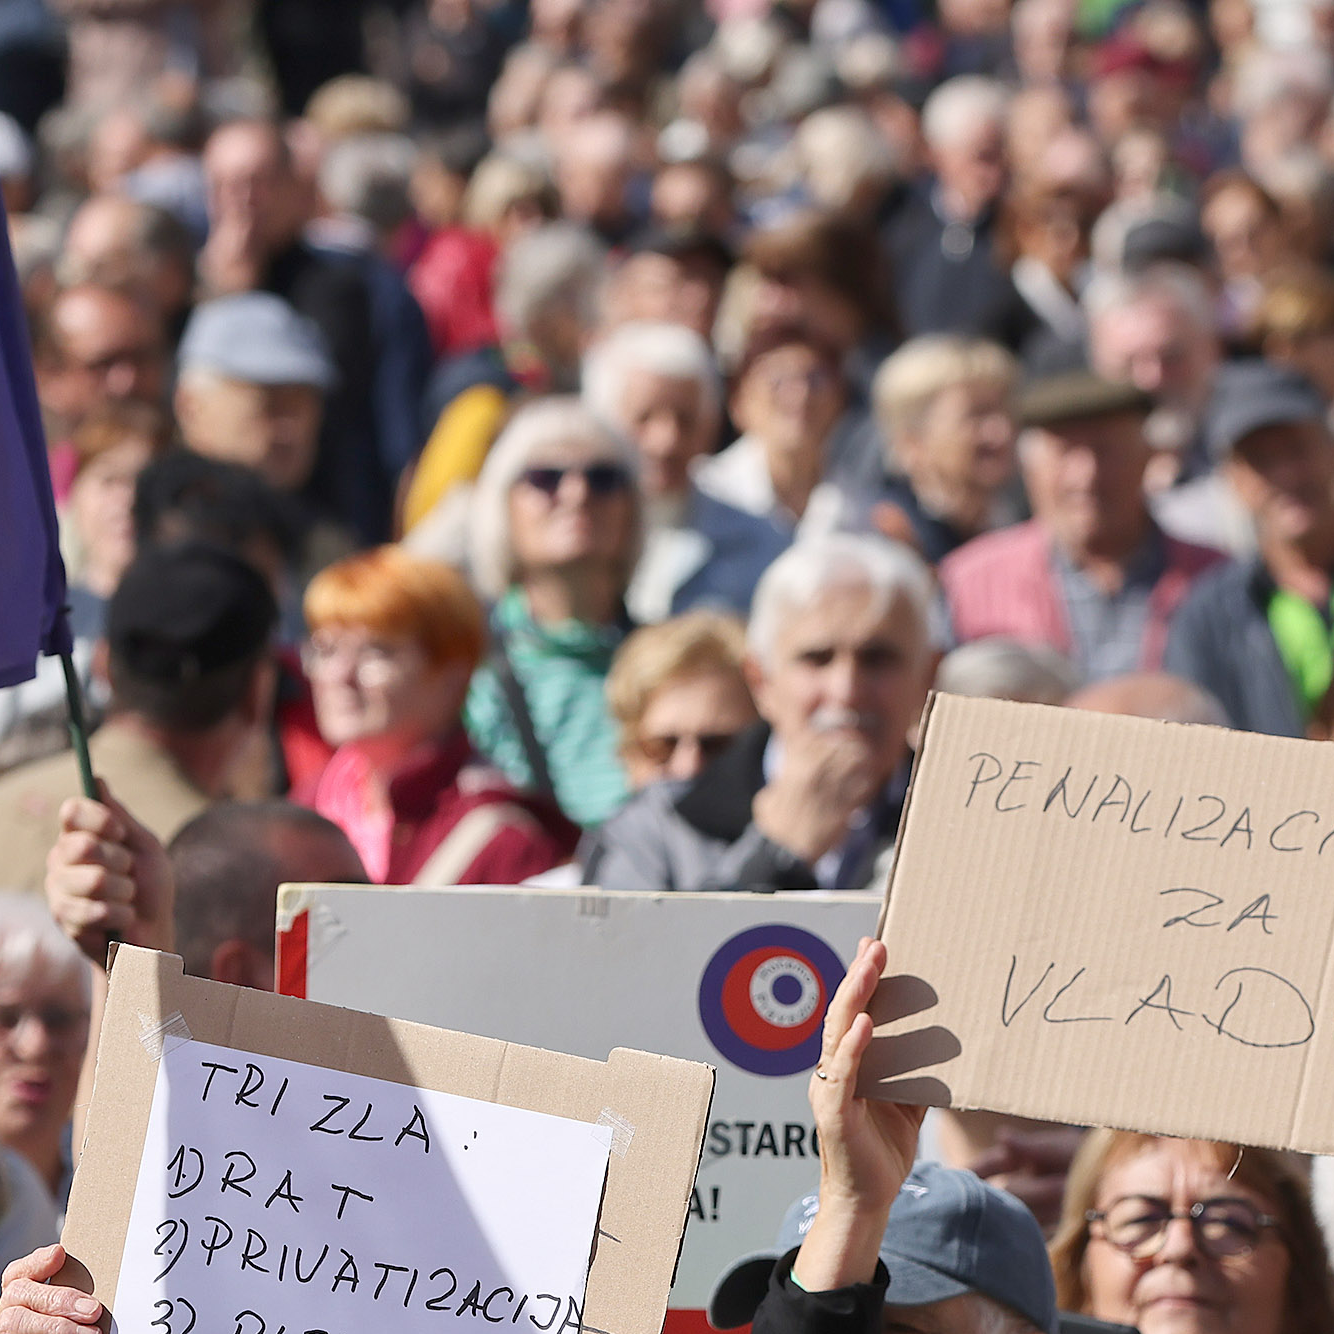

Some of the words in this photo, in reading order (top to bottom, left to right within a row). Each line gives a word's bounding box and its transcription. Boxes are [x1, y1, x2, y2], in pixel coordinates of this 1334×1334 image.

[1160, 888, 1279, 934] ZA
[200, 1061, 289, 1116] TRI
[221, 1150, 373, 1220] RAT
